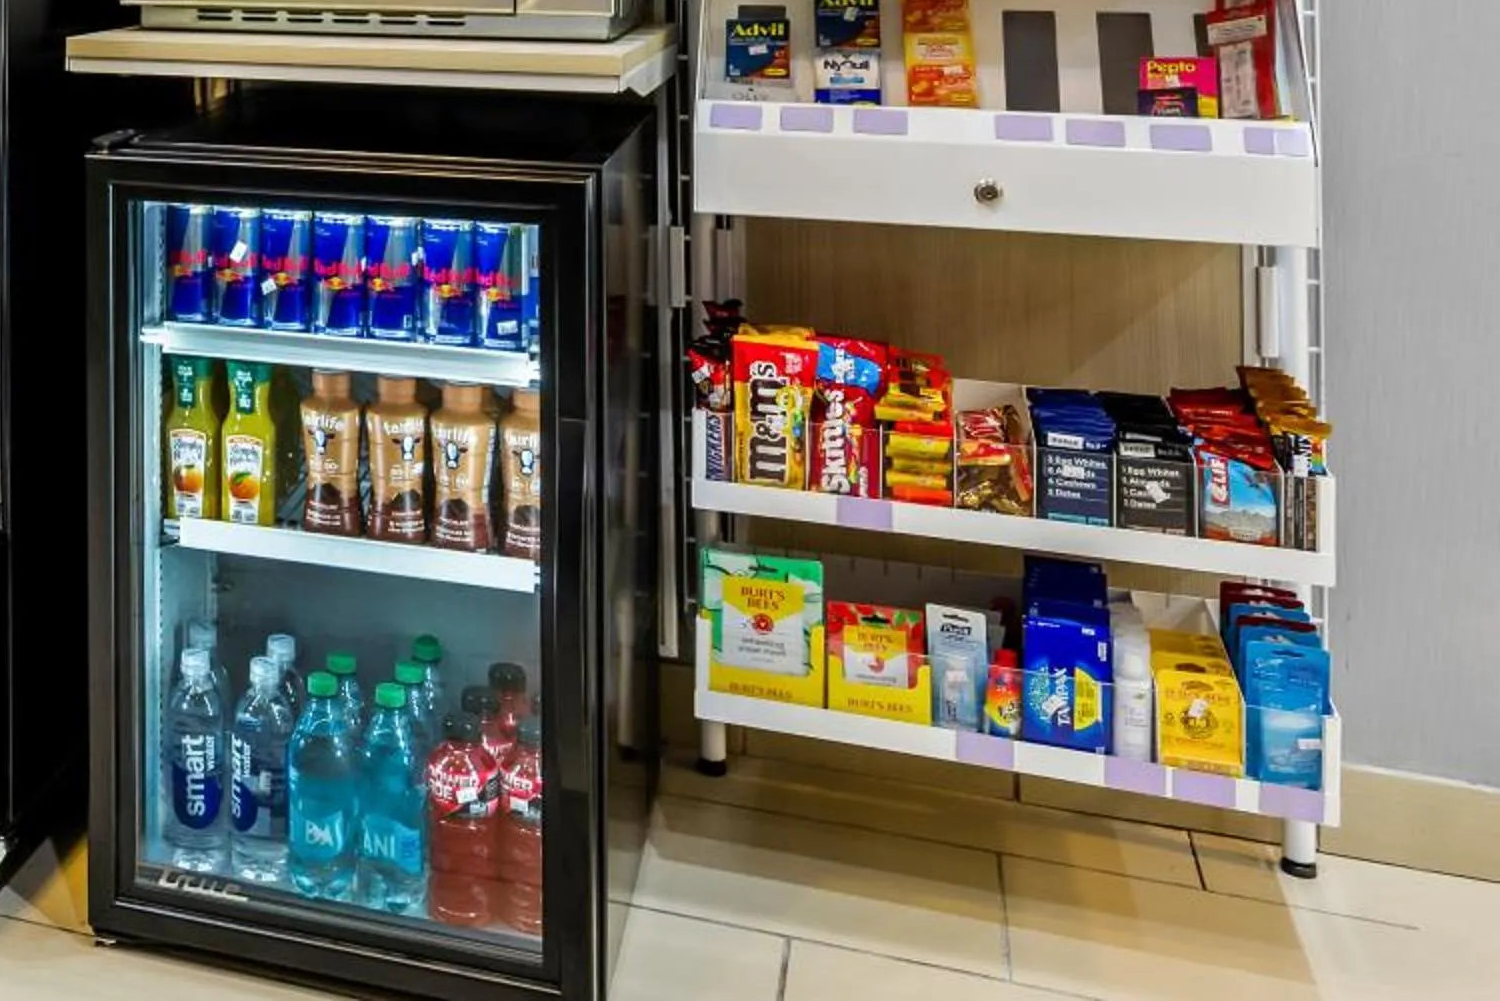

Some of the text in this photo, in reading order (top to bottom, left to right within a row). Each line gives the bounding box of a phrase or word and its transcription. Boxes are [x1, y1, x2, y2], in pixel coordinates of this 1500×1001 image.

[733, 21, 786, 37] Advil
[1147, 60, 1197, 75] Pepto
[741, 586, 786, 601] BURT'S
[747, 599, 780, 611] BEES
[181, 734, 215, 817] smart water
[231, 733, 243, 819] smart
